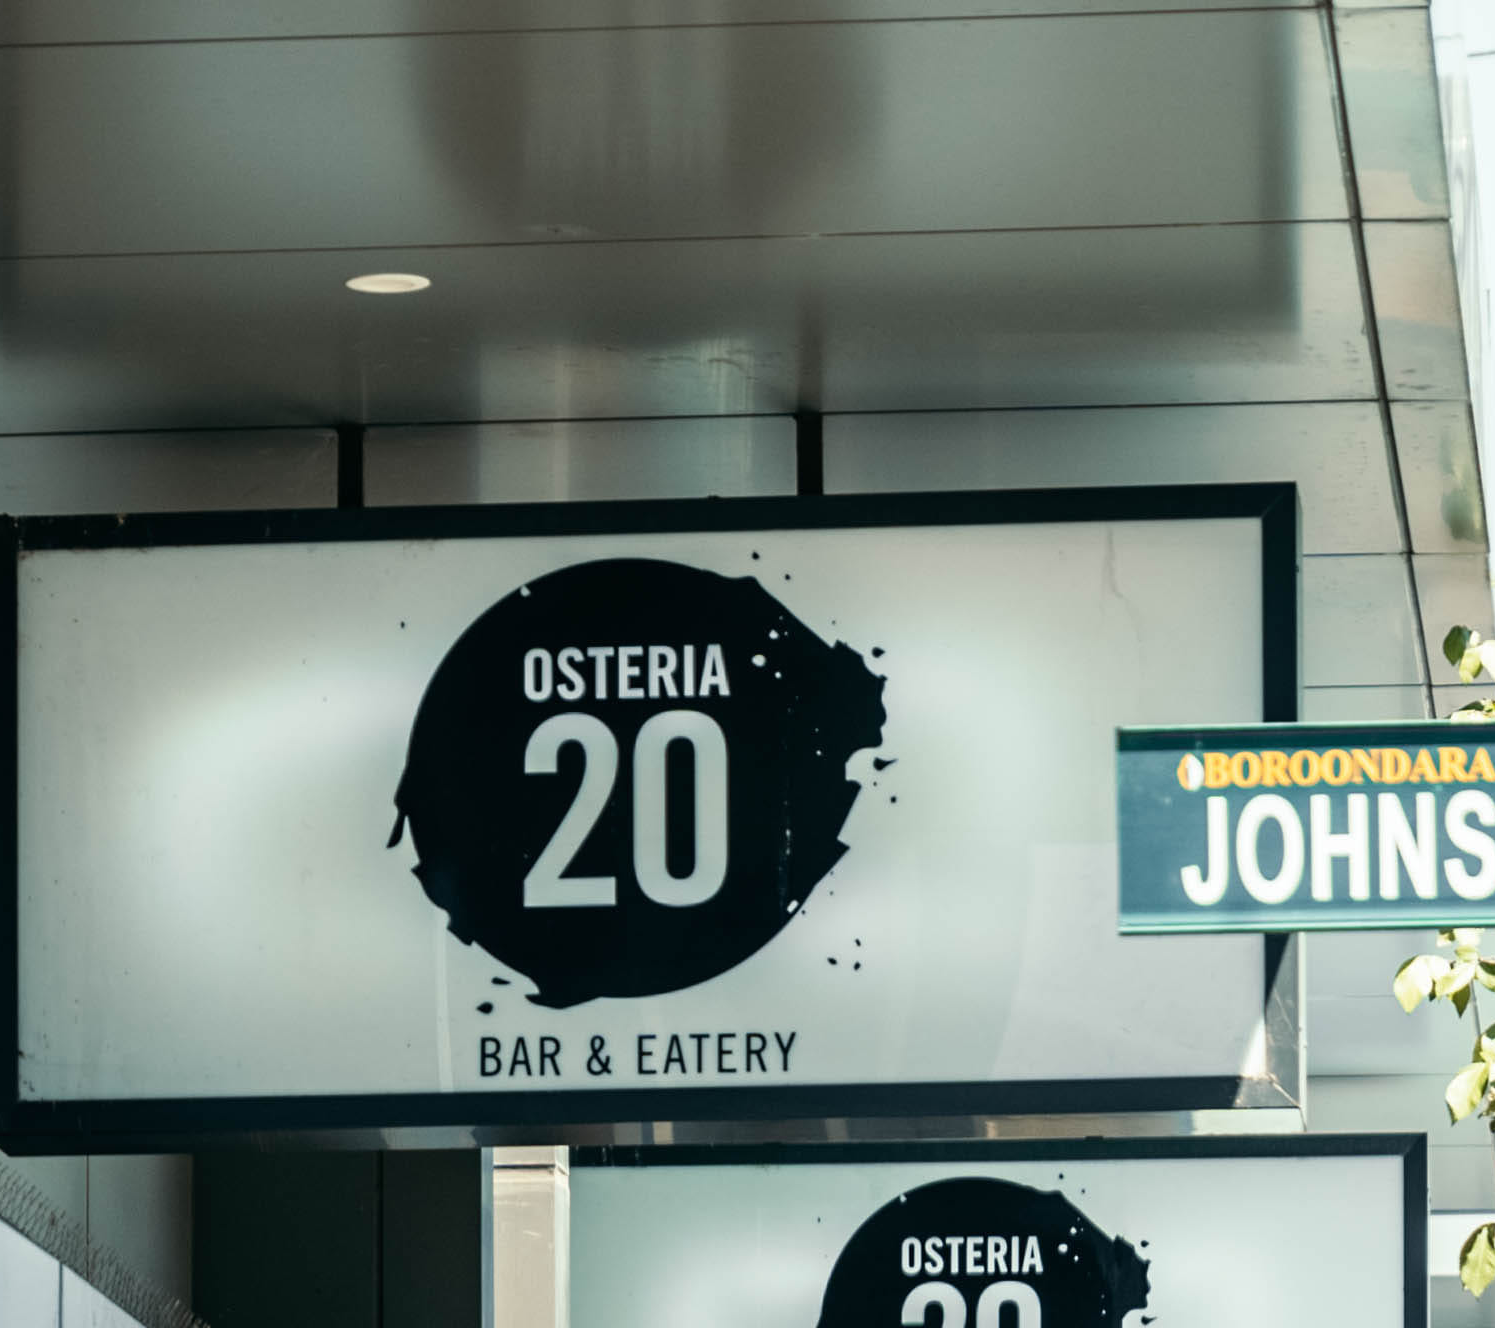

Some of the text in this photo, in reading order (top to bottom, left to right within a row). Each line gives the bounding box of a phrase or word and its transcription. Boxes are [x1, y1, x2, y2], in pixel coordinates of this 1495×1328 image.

[524, 643, 730, 701] OSTERIA
[523, 709, 729, 909] 20
[478, 1031, 798, 1078] BAR & EATERY
[901, 1235, 1044, 1276] OSTERIA
